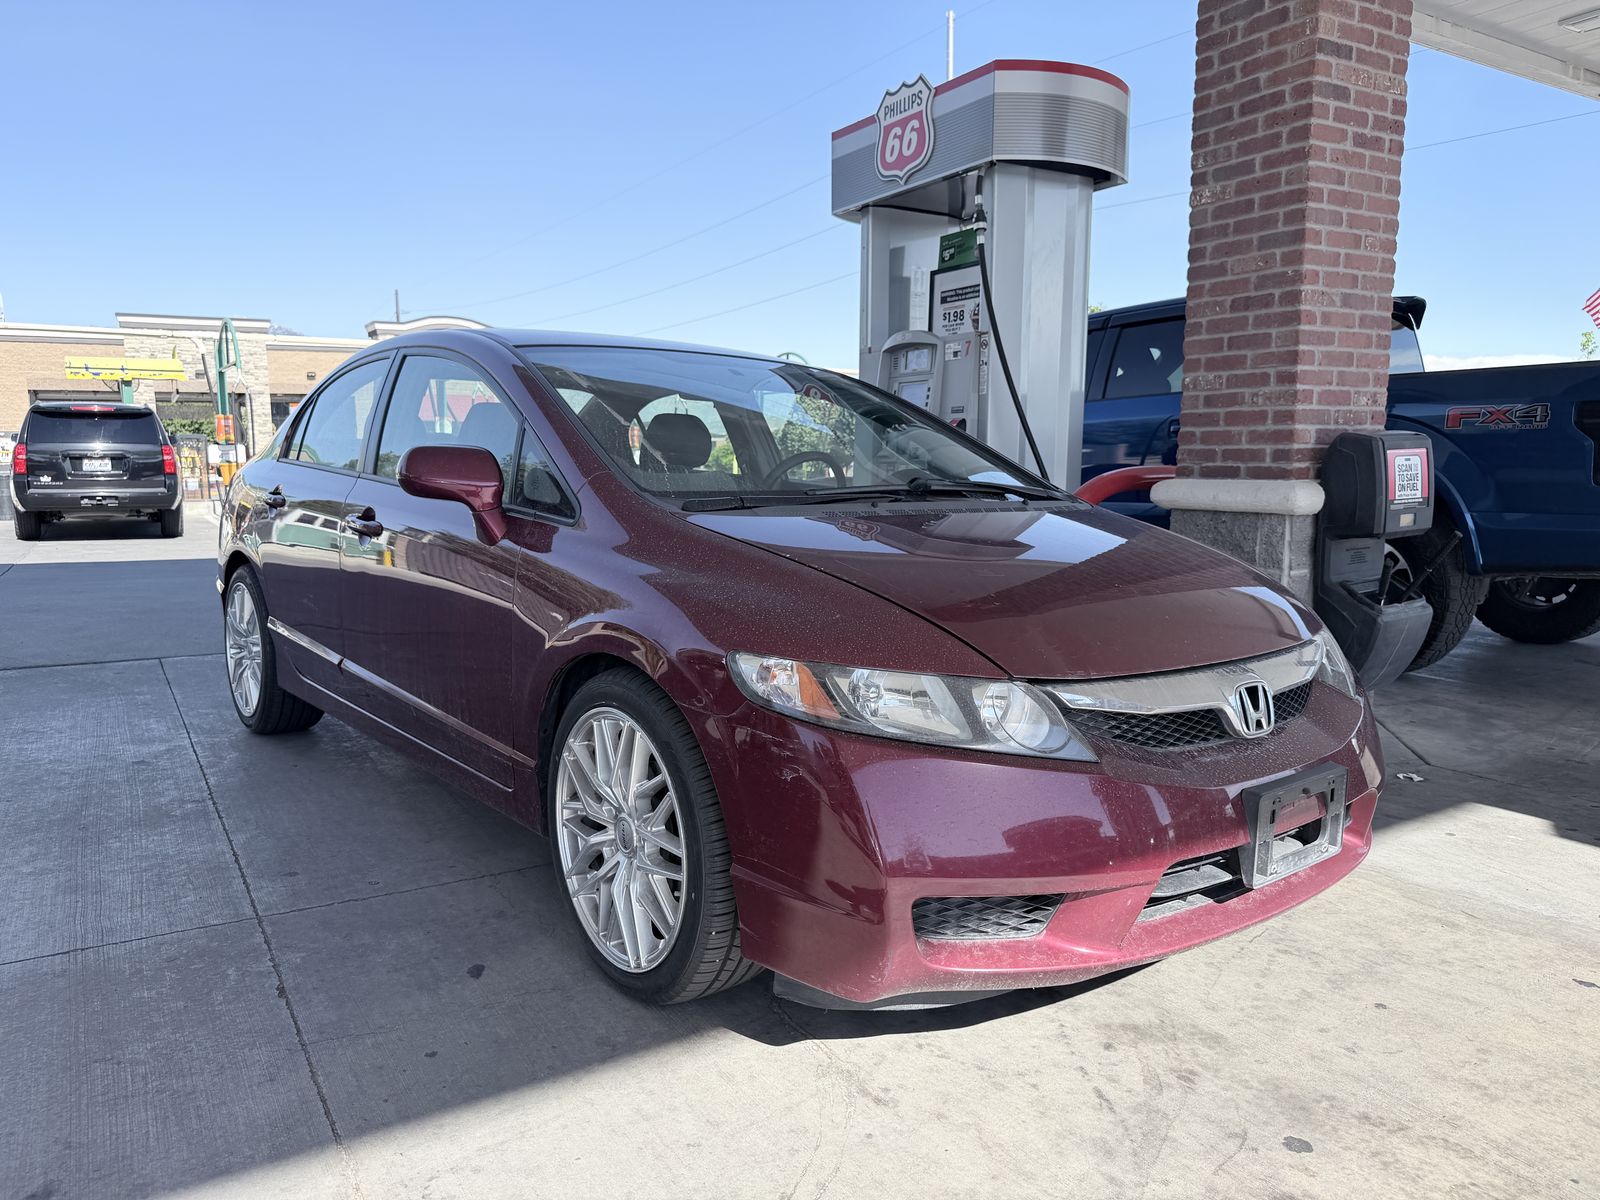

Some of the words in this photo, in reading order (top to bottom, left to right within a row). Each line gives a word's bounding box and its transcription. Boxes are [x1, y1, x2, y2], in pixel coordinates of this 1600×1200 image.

[883, 90, 923, 121] PHILLIPS
[885, 119, 920, 163] 66
[942, 309, 965, 323] $1.98
[964, 340, 972, 357] 7
[1444, 403, 1550, 430] FX4
[1397, 463, 1413, 473] SCAN
[1397, 473, 1405, 483] TO
[1405, 472, 1419, 482] SAVE
[1397, 483, 1406, 493] ON
[1406, 482, 1419, 492] FUEL
